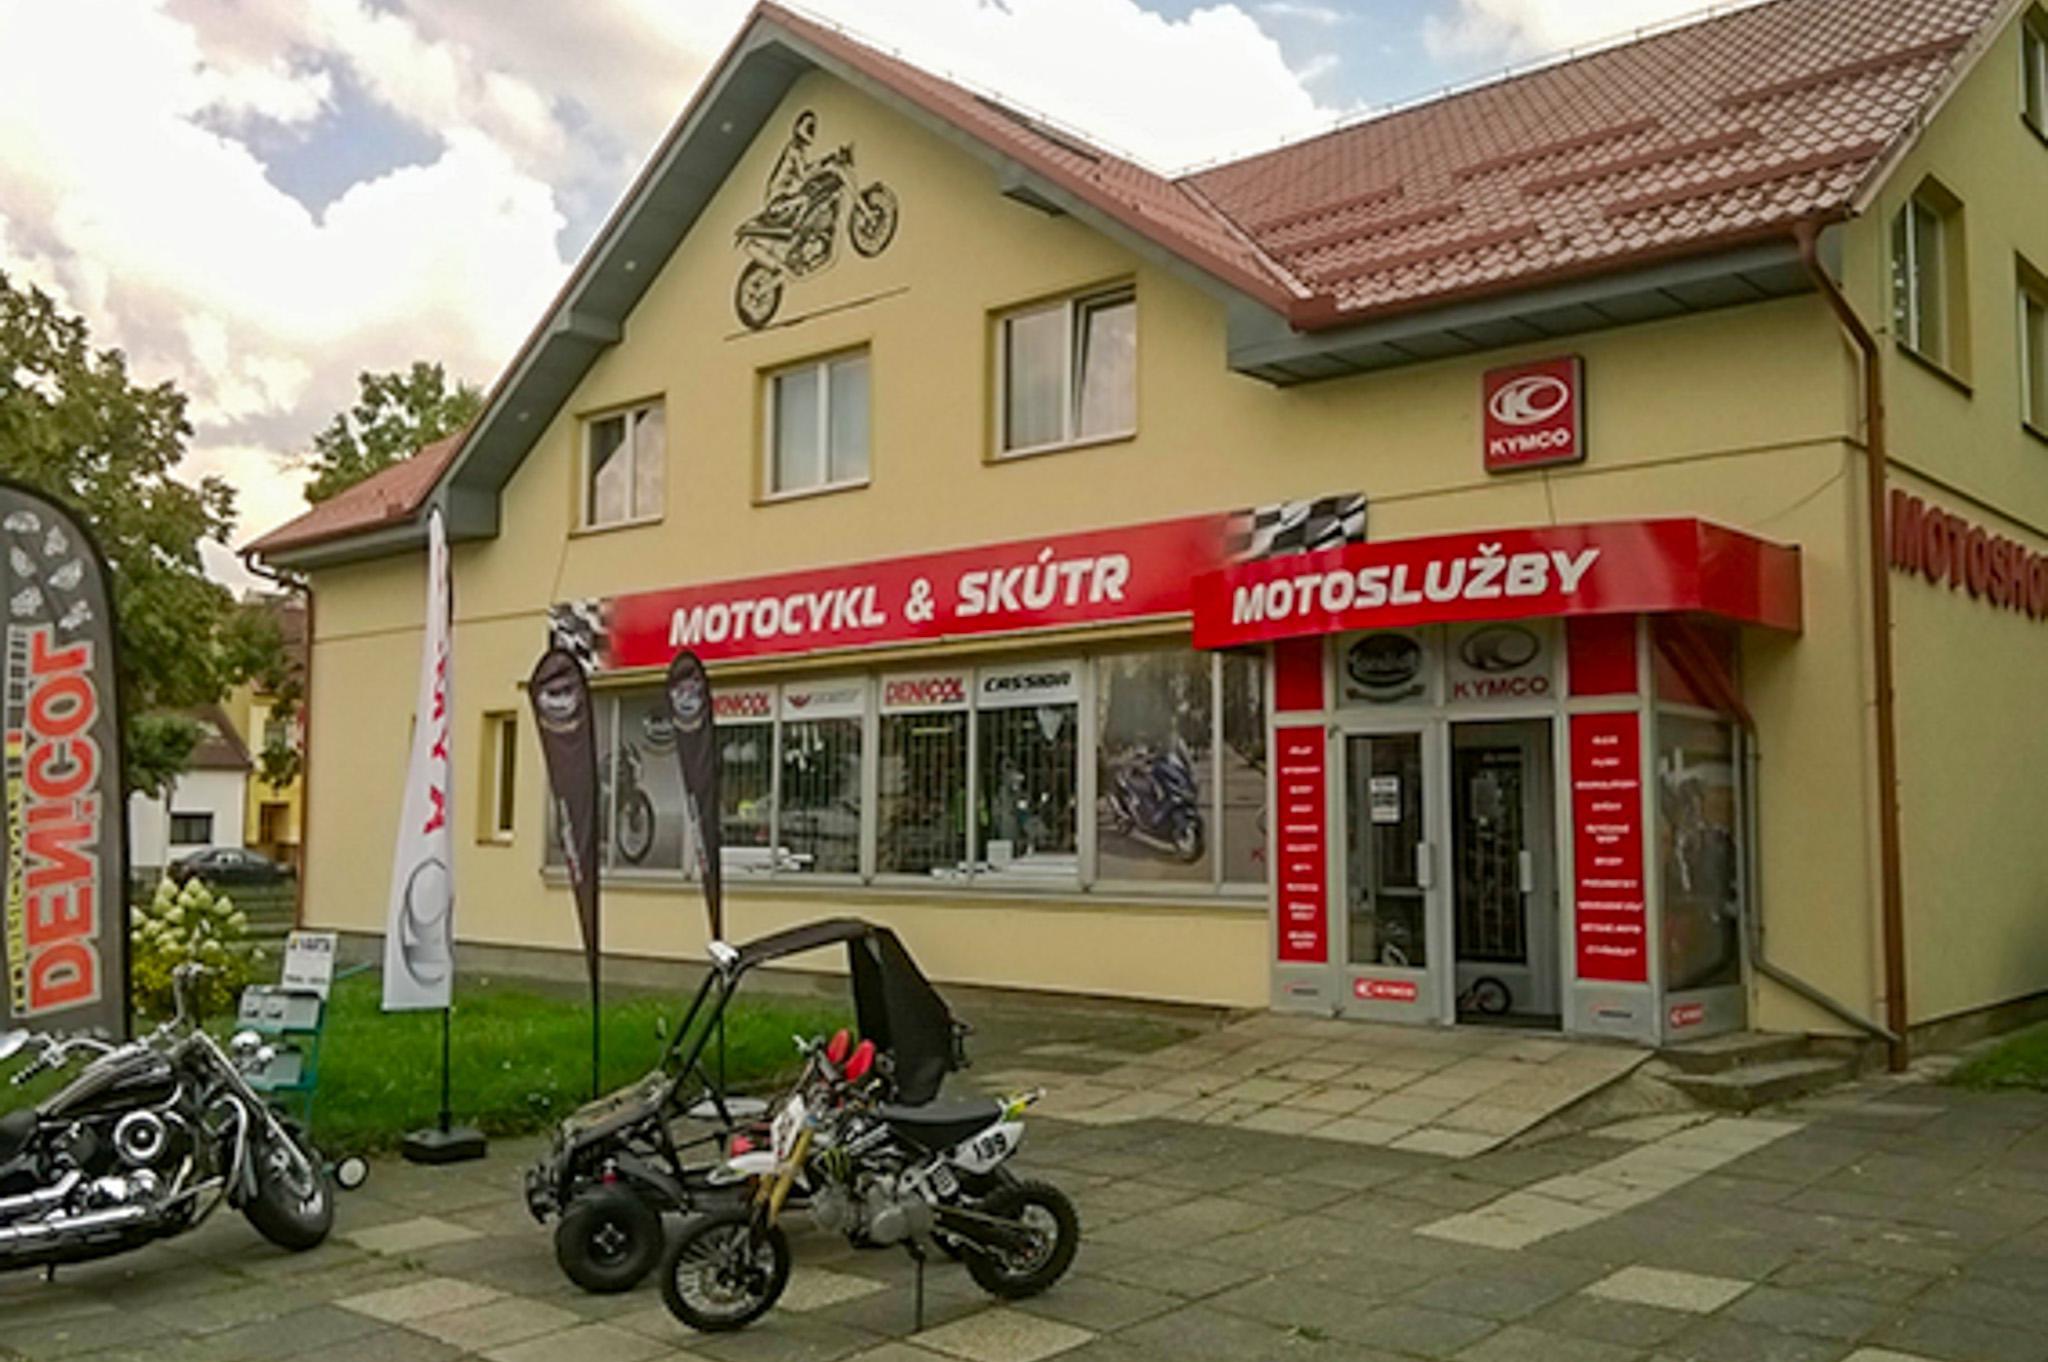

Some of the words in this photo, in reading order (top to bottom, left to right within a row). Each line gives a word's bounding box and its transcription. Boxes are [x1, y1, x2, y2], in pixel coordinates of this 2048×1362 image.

[1489, 427, 1571, 456] KYMCO
[669, 586, 886, 646] MOTOCYKL
[904, 578, 935, 624] &
[956, 547, 1130, 617] SKÚTR
[1231, 543, 1601, 626] MOTOSLUŽBY
[1453, 675, 1550, 698] KYMCO
